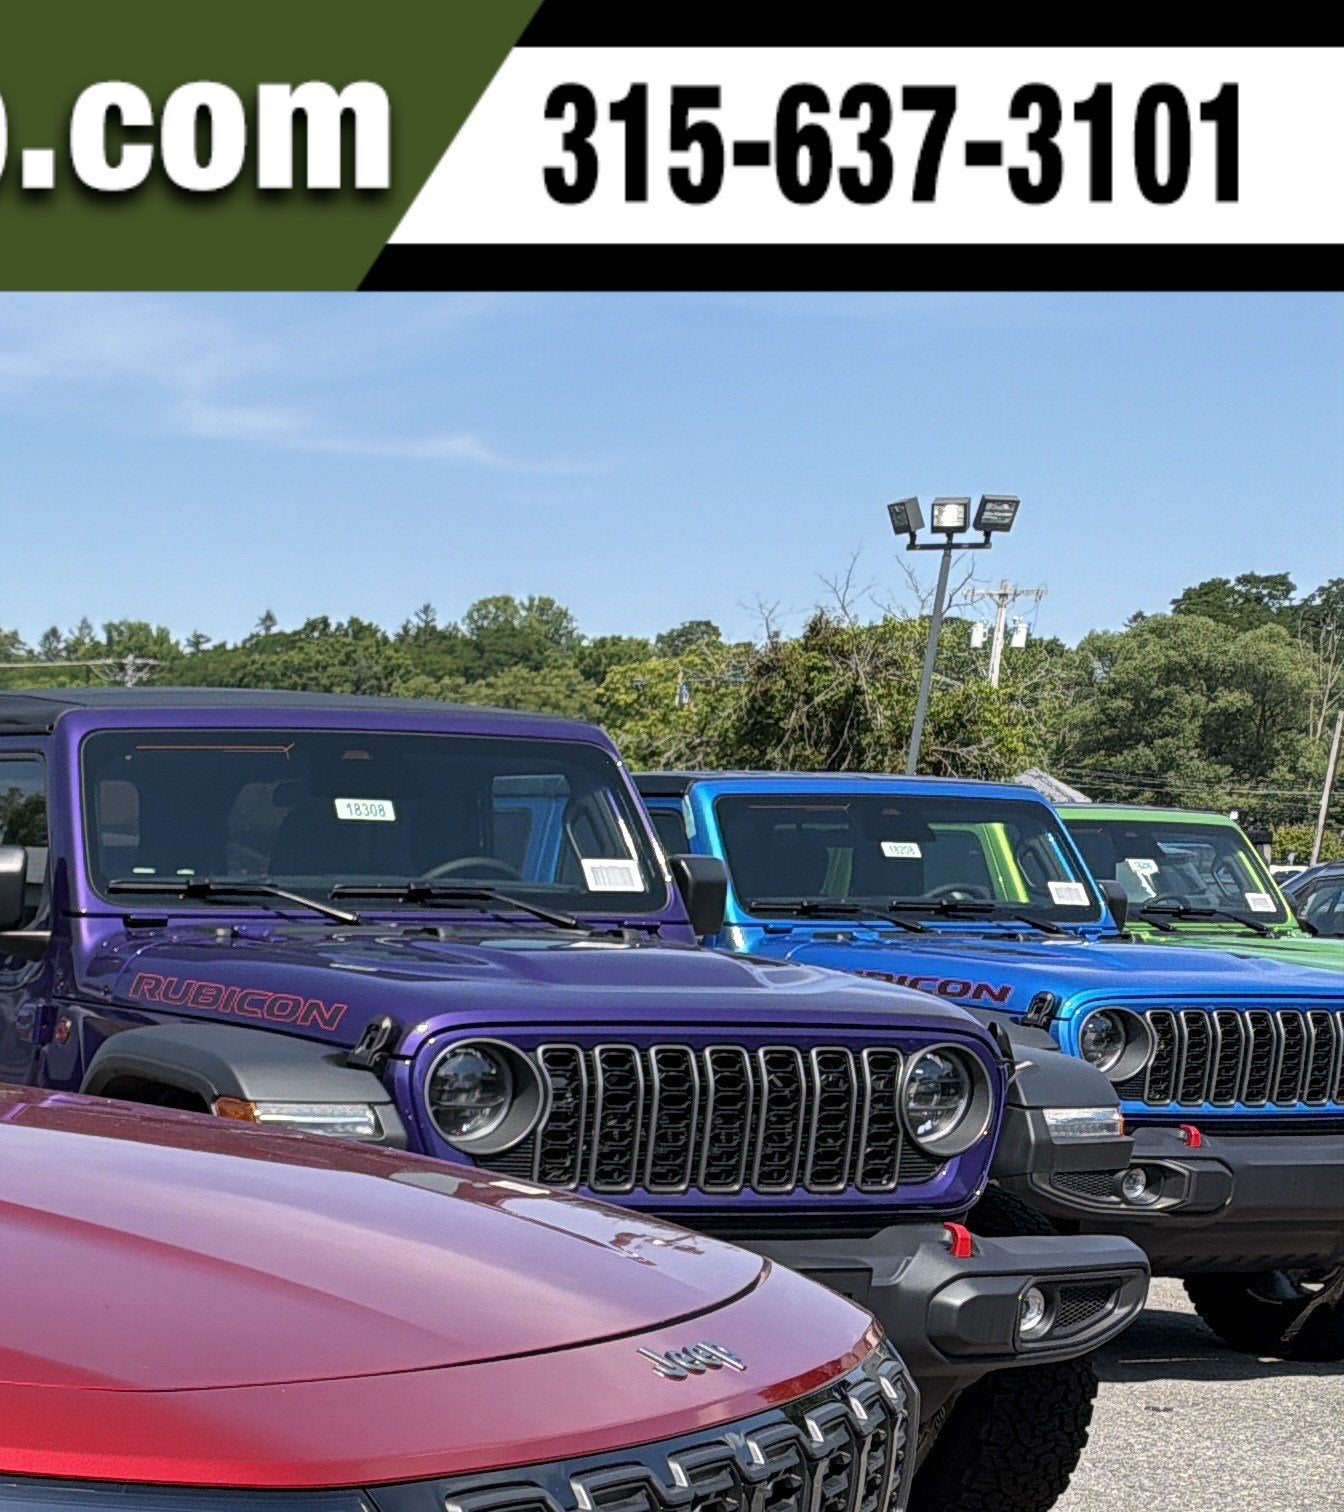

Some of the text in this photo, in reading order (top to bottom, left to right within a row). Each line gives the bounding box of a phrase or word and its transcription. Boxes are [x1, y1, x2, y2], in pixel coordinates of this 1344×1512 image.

[346, 802, 387, 818] 18308
[128, 972, 348, 1032] RUBICON
[636, 1340, 748, 1382] Jeep
